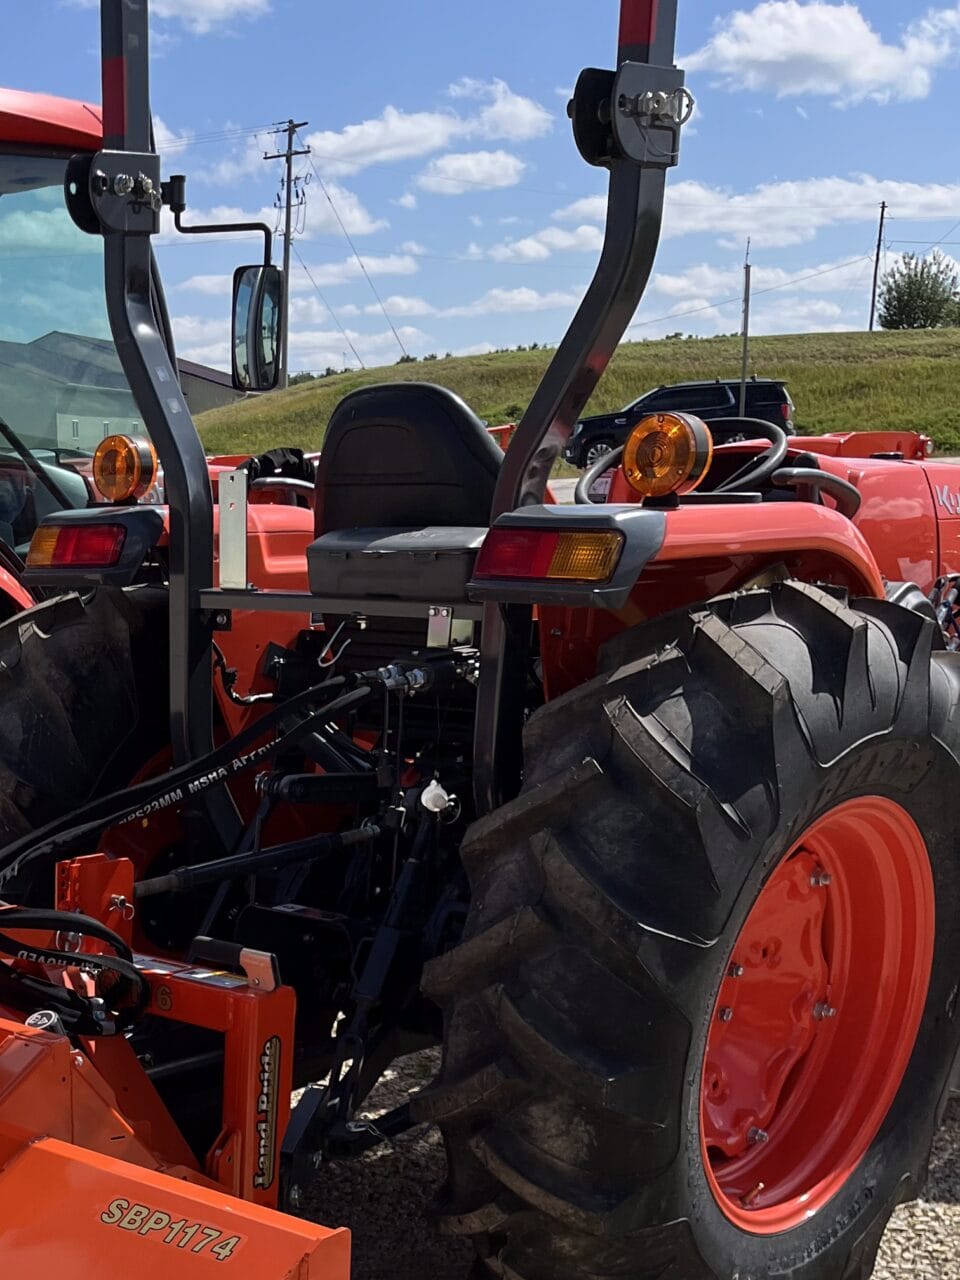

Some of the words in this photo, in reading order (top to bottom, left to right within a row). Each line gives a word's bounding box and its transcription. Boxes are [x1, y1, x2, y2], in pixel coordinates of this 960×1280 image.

[187, 766, 229, 795] MSHA
[257, 1040, 273, 1113] Pride
[254, 1122, 269, 1188] Land
[100, 1198, 242, 1261] SBP1174
